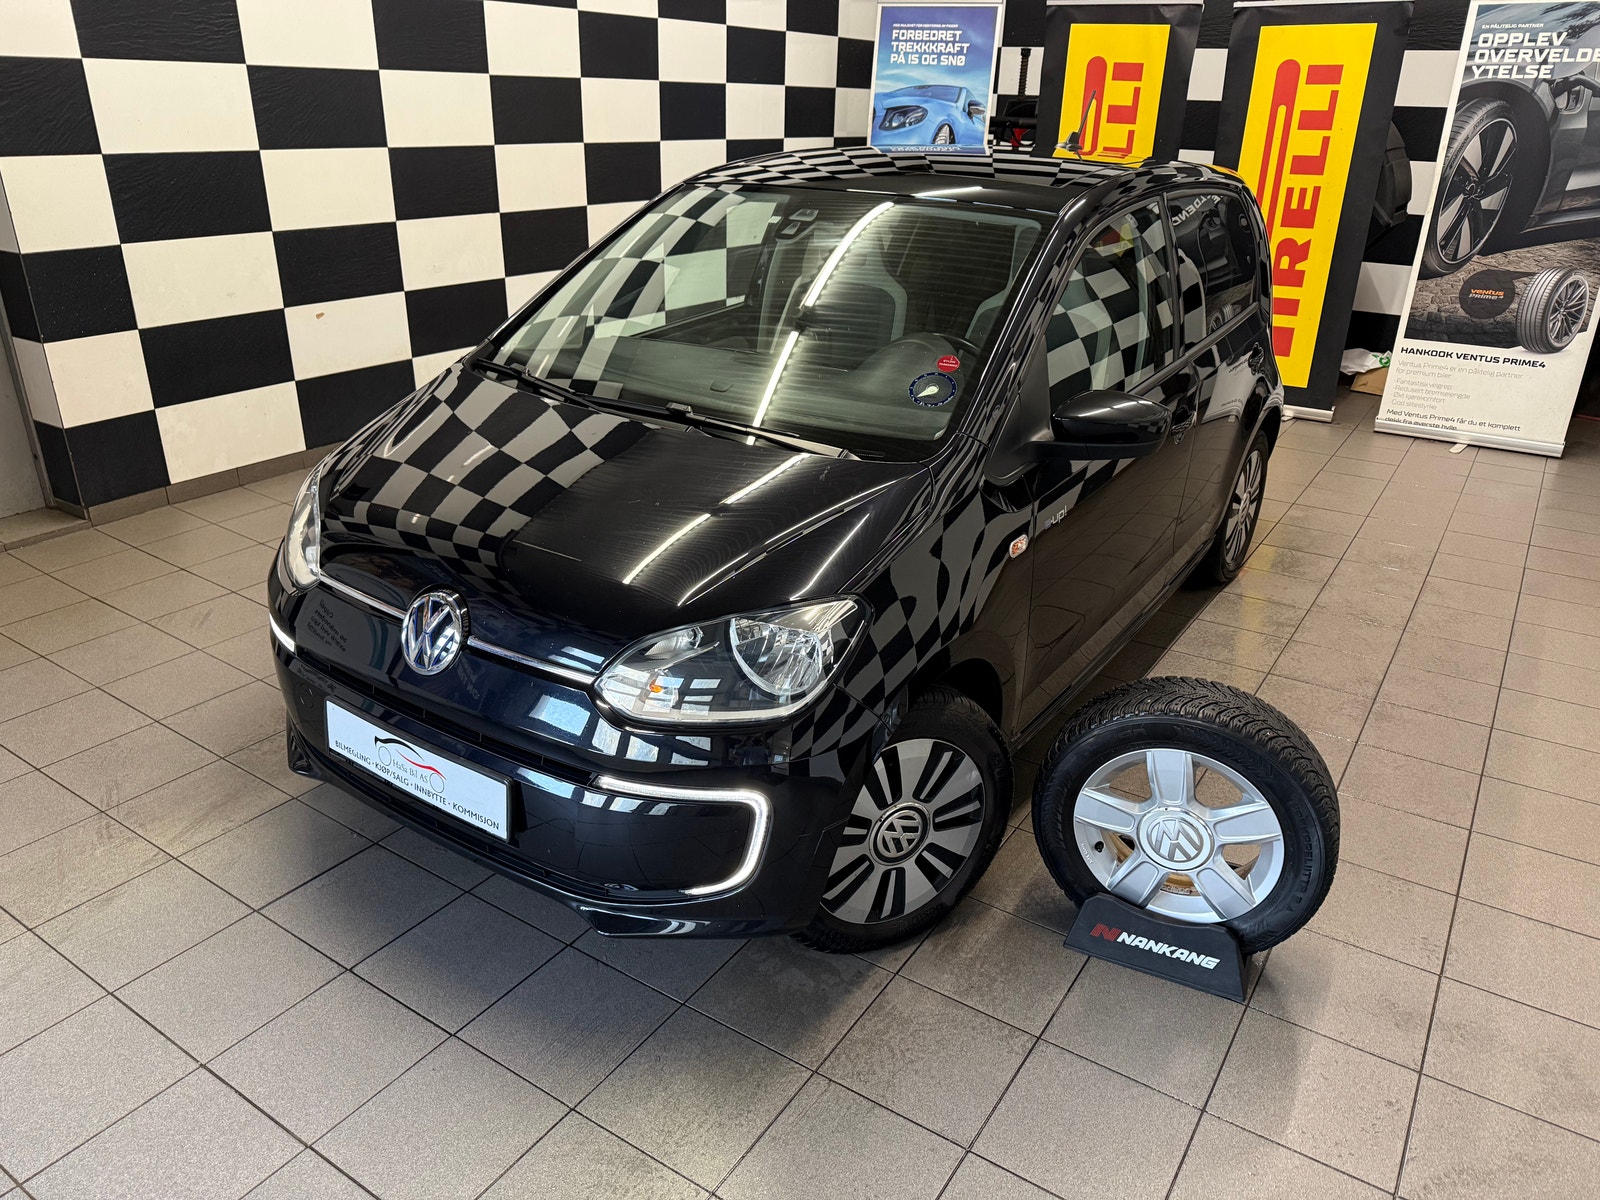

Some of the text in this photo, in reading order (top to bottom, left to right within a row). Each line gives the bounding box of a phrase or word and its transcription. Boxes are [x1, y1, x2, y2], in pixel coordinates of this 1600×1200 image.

[892, 29, 963, 41] FORBEDRET
[1478, 32, 1568, 47] OPPLEV
[891, 42, 970, 54] TREKKKRAFT
[890, 51, 966, 66] PÅ IS OG SNØ
[1471, 64, 1554, 79] YTELSE
[1400, 347, 1546, 368] HANKOOK VENTUS PRIME4
[1398, 360, 1421, 368] Ventus
[1422, 362, 1448, 370] Prime4
[1468, 368, 1495, 377] pålitelig
[1496, 371, 1524, 379] partner
[1406, 369, 1436, 377] premium
[1394, 384, 1423, 393] Redusert
[1404, 411, 1428, 420] Ventus
[1429, 414, 1455, 422] Prime4
[1488, 422, 1520, 432] komplett
[335, 740, 371, 766] BILMEGLING
[410, 768, 418, 778] Bil
[420, 774, 428, 784] AS
[375, 762, 500, 830] KJØP/SALG INNBYTTE KOMMISJON
[1116, 931, 1221, 970] NANKANG
